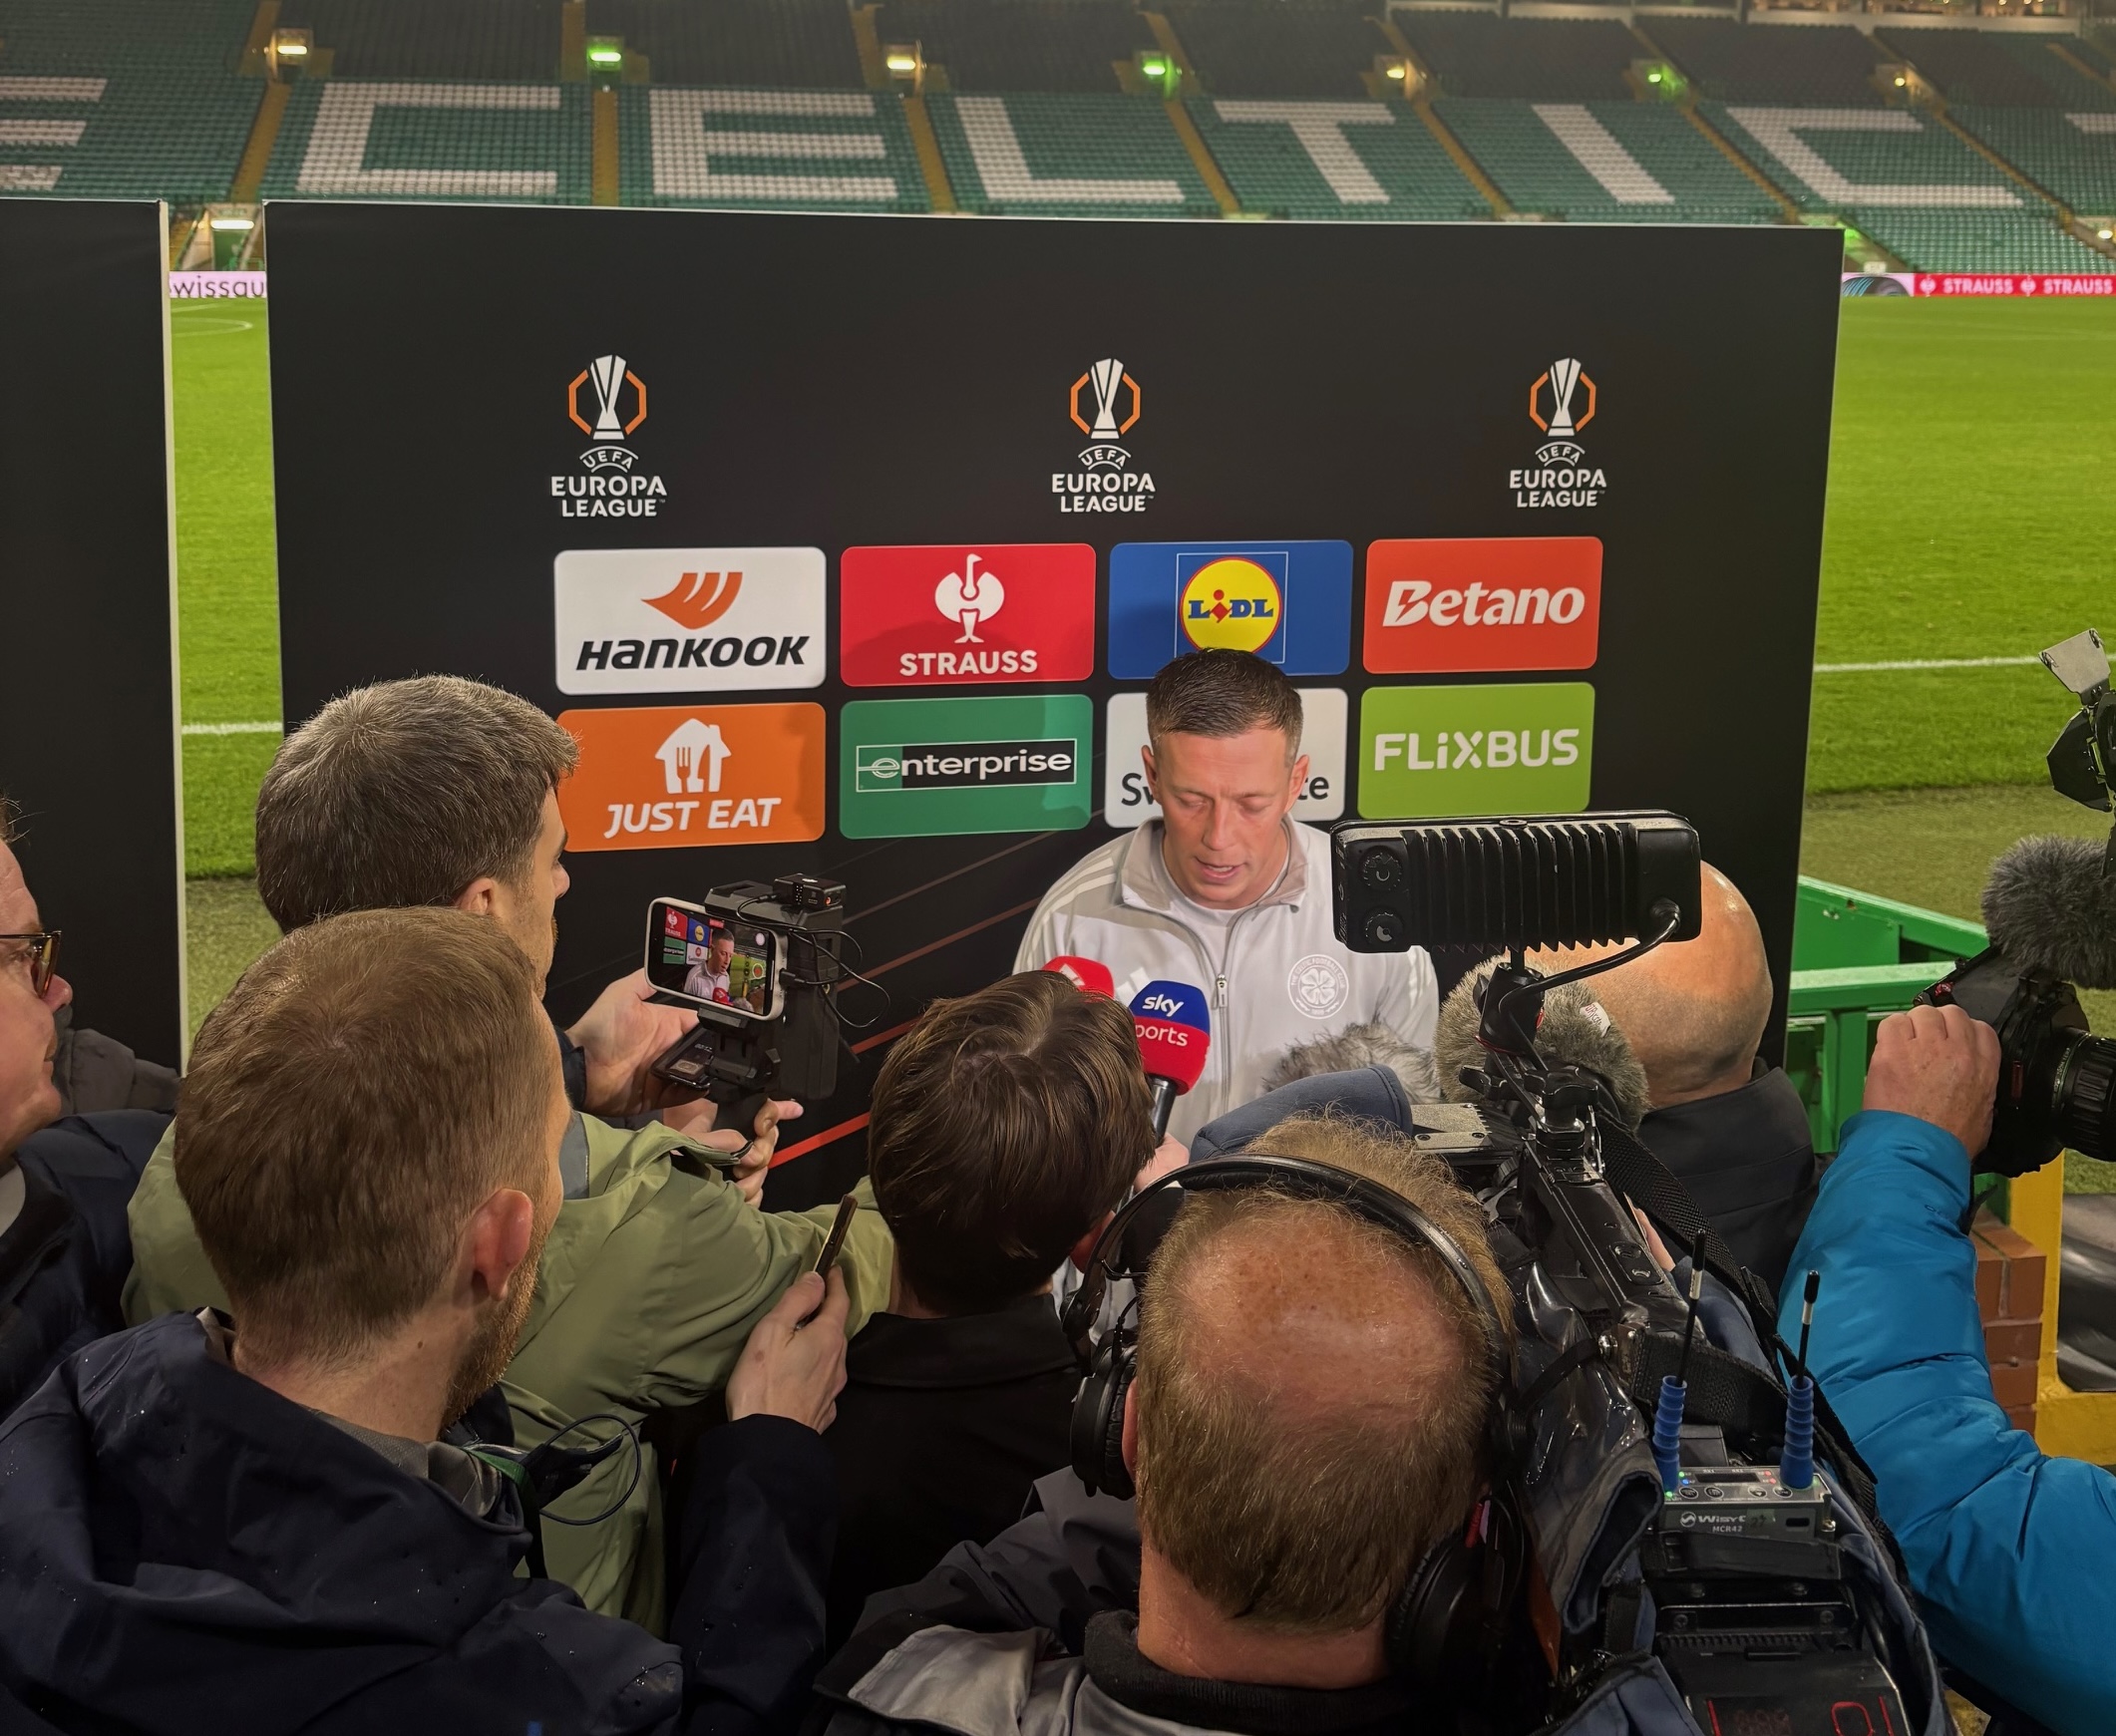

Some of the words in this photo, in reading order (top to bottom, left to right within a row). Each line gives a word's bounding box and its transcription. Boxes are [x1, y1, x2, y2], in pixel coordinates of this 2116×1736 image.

[296, 82, 2025, 206] CELTIC
[1943, 277, 2013, 294] STRAUSS
[2043, 278, 2114, 295] STRAUSS
[582, 450, 633, 470] UEFA
[1080, 449, 1127, 468] UEFA
[1538, 446, 1581, 464] UEFA
[550, 476, 667, 497] EUROPA
[1052, 473, 1156, 493] EUROPA
[1509, 469, 1607, 489] EUROPA
[561, 499, 657, 518] LEAGUE
[1060, 495, 1147, 513] LEAGUE
[1517, 491, 1597, 508] LEAGUE
[1382, 580, 1586, 627] Betano
[899, 649, 1038, 676] STRAUSS
[871, 748, 1072, 780] enterprise
[603, 800, 701, 839] JUST
[707, 797, 781, 829] EAT
[1142, 994, 1185, 1017] sky
[1135, 1024, 1189, 1047] ports
